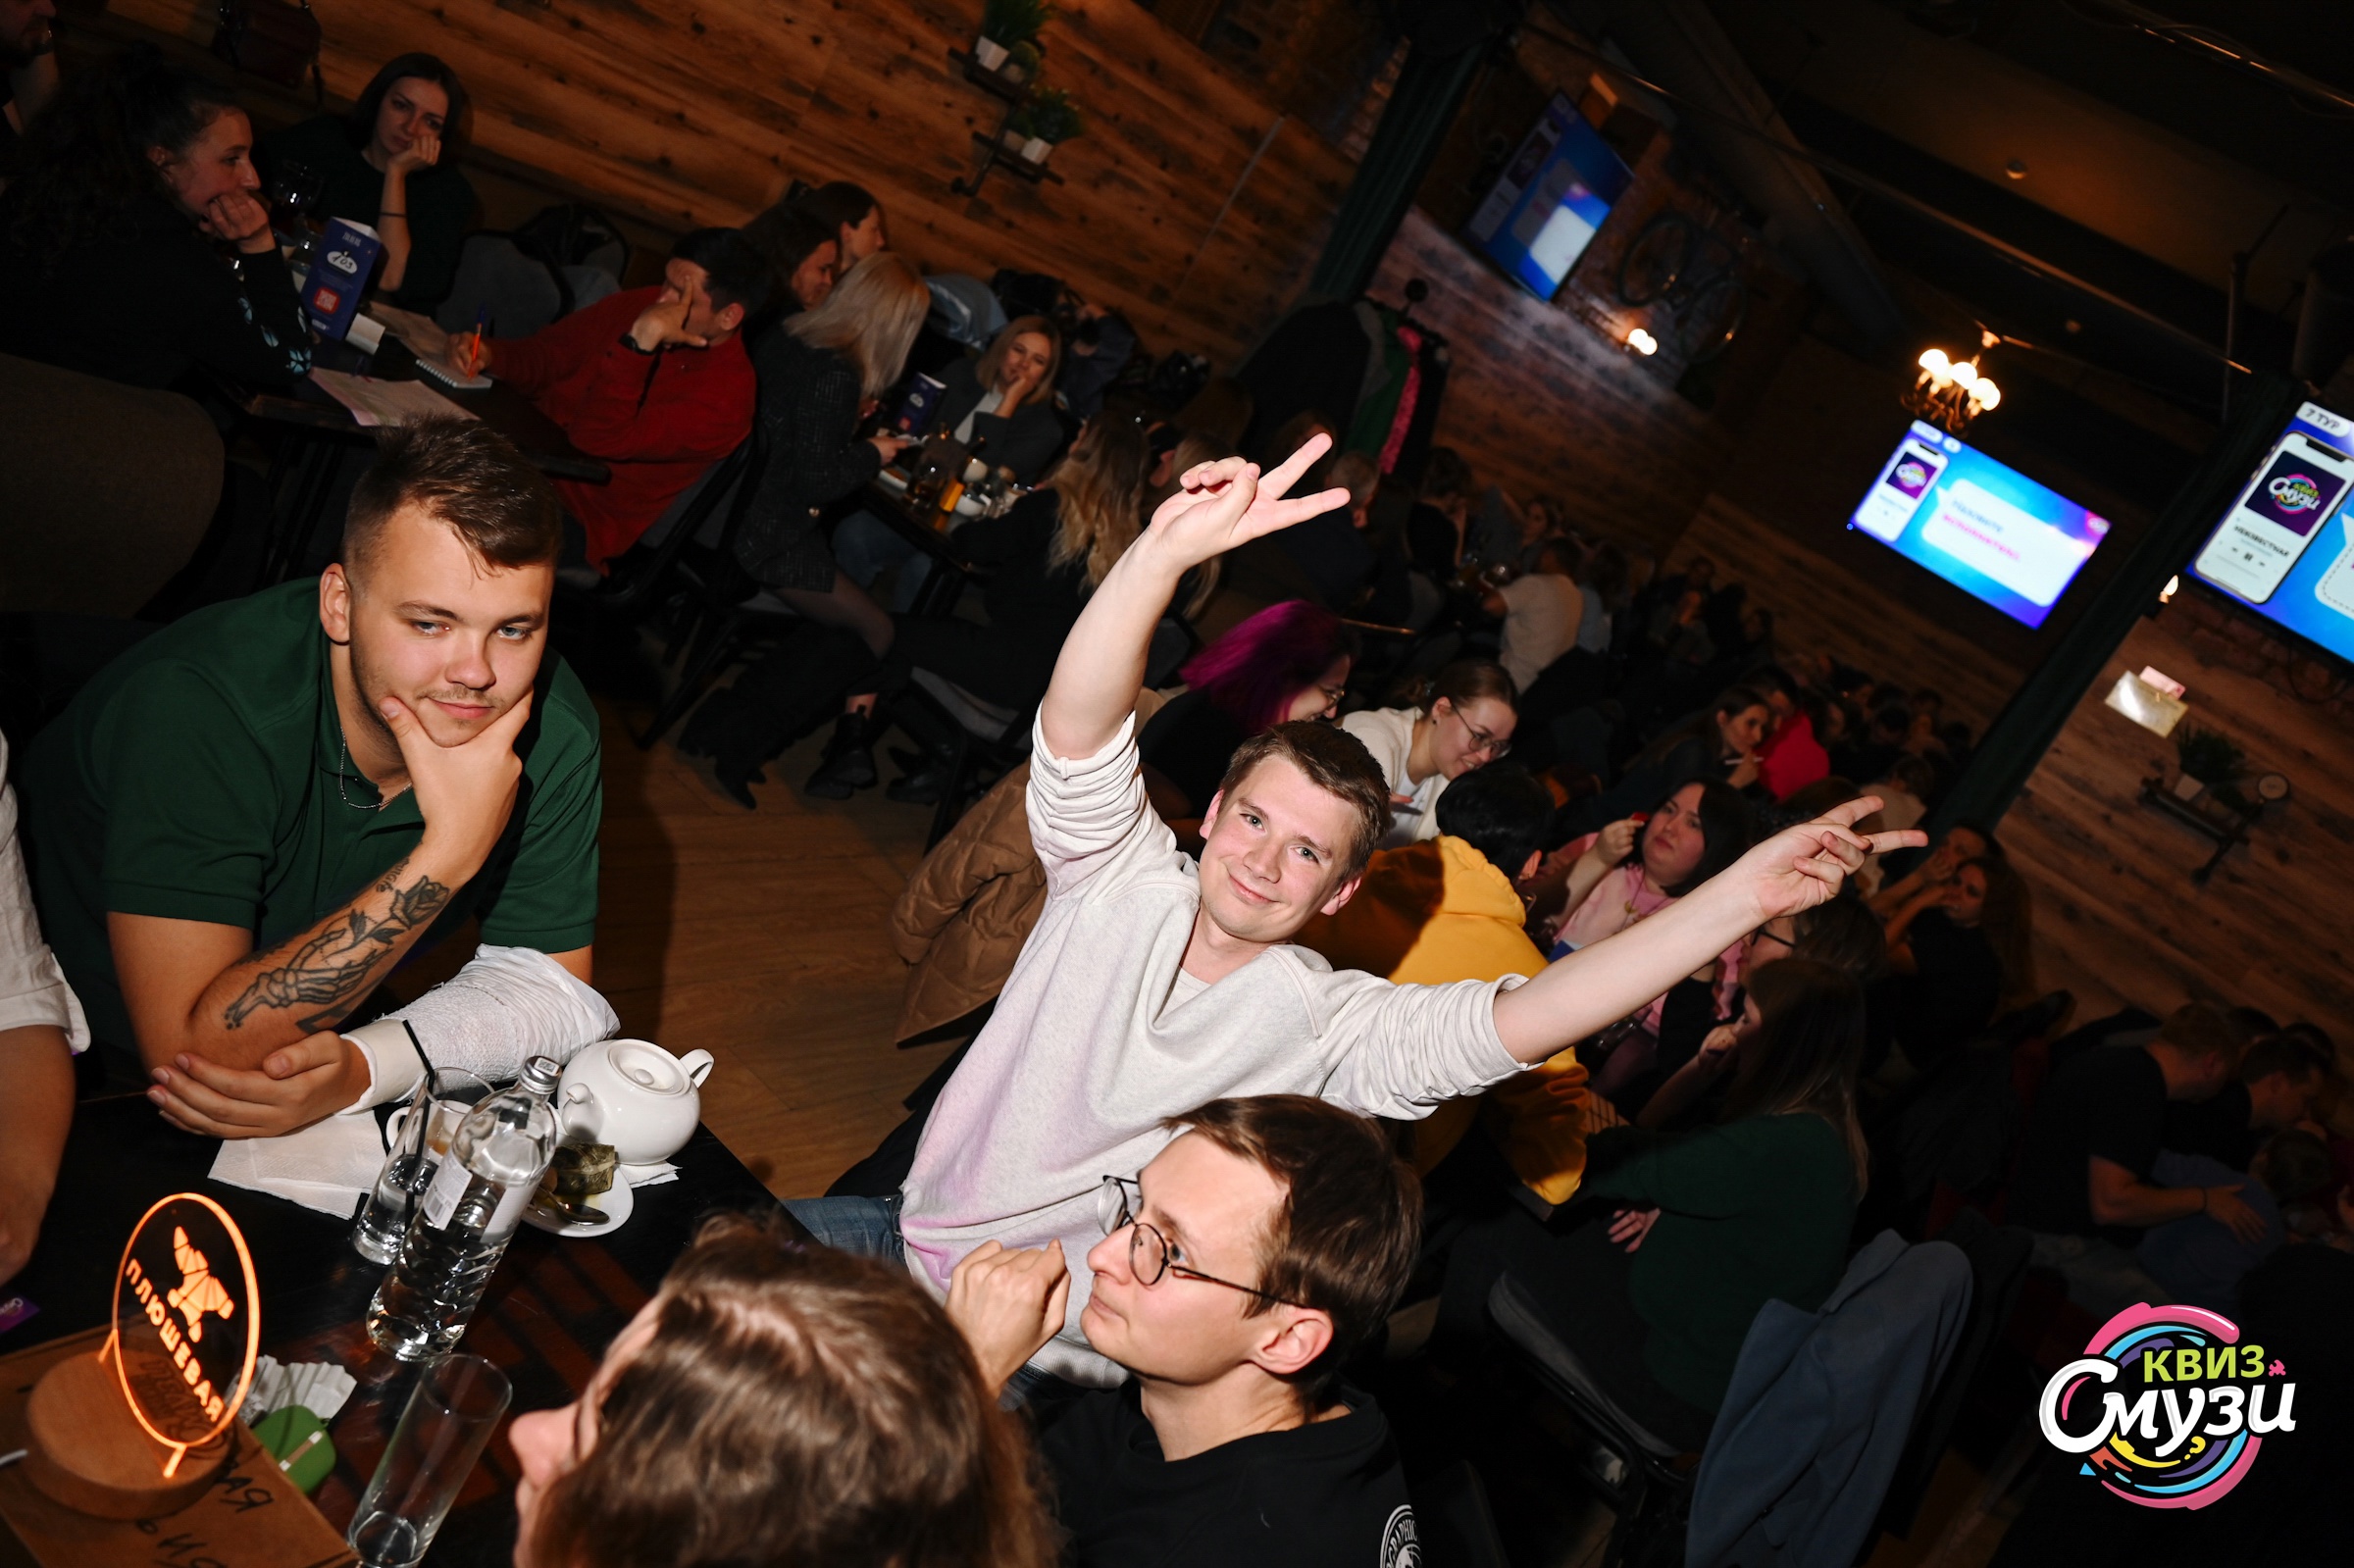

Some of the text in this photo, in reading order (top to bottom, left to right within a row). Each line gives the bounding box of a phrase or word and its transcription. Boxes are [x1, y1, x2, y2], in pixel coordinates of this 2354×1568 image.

[2305, 408, 2340, 430] 7 ТУР
[2268, 477, 2321, 510] Смузи
[126, 1258, 225, 1423] ПЛЮШЕВАЯ
